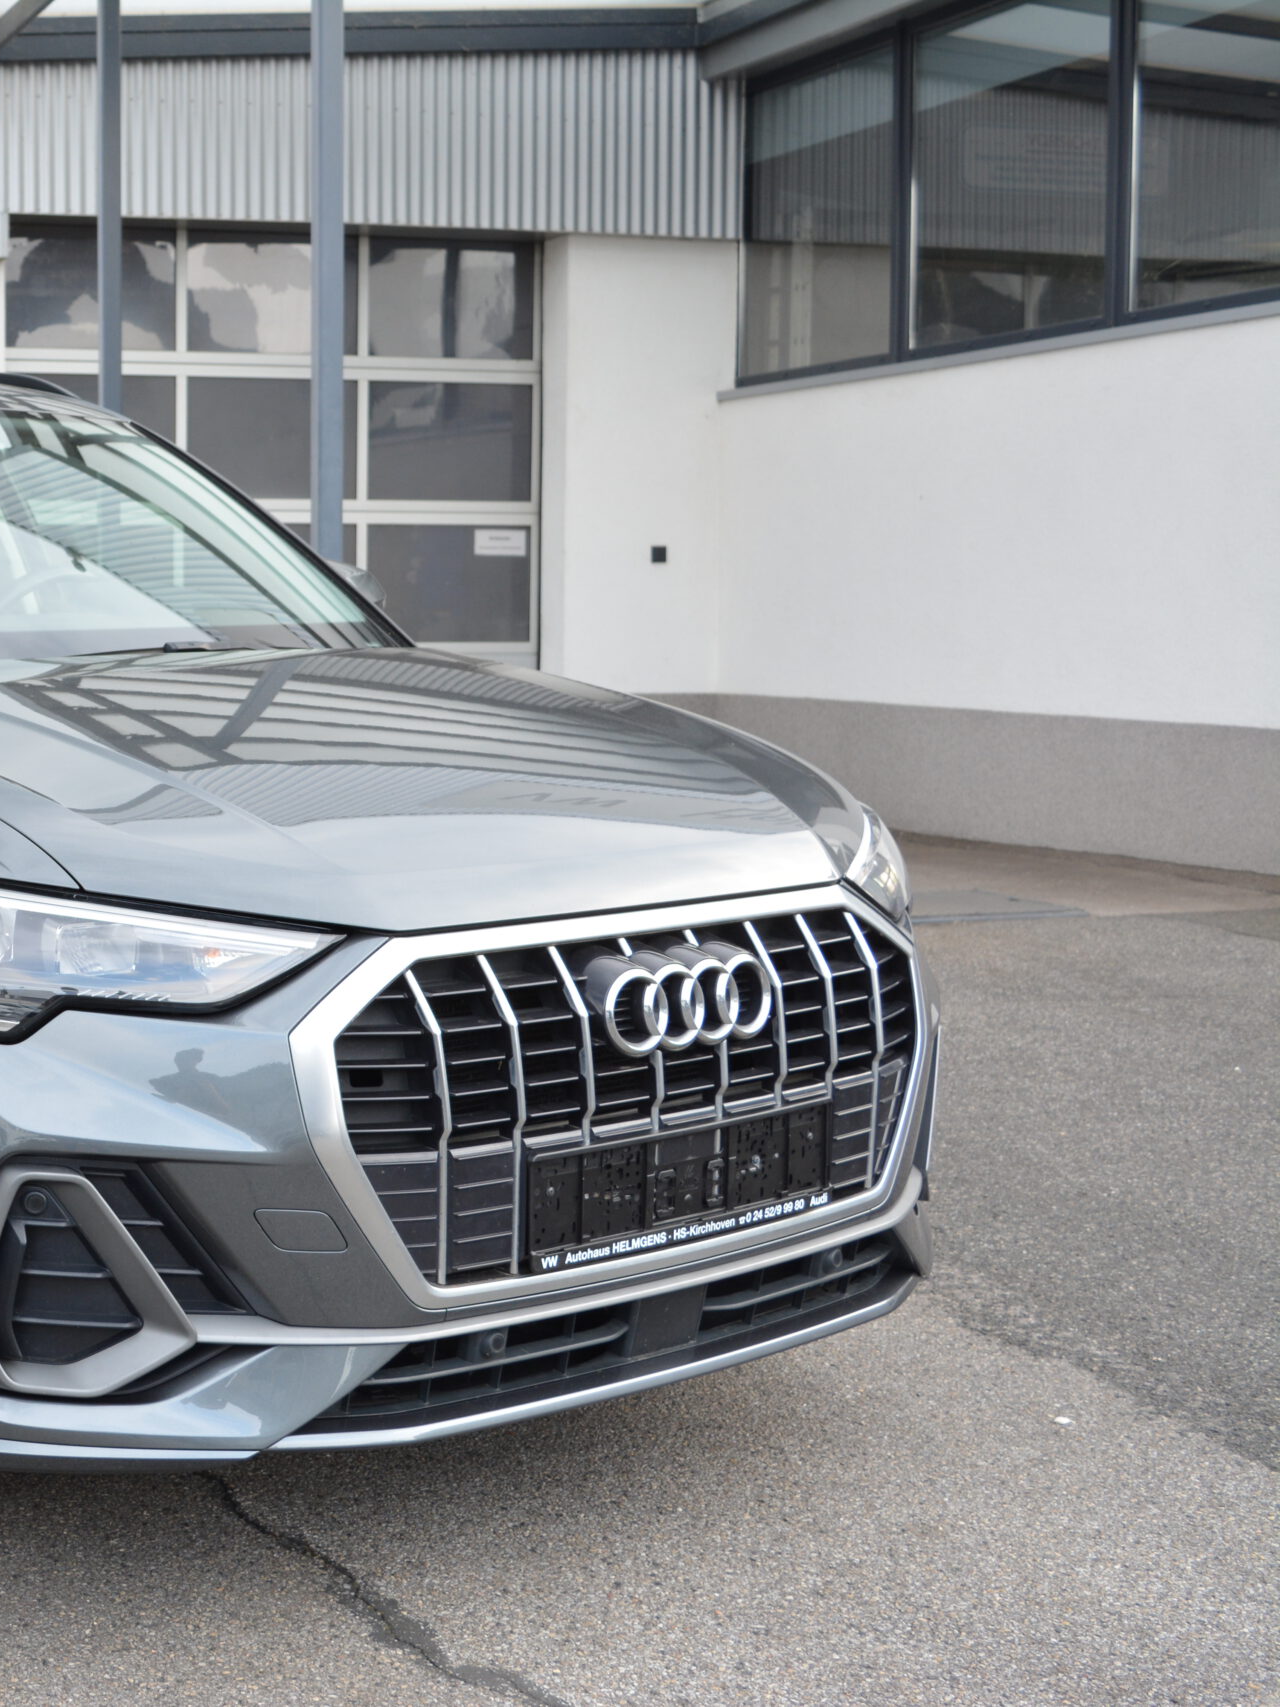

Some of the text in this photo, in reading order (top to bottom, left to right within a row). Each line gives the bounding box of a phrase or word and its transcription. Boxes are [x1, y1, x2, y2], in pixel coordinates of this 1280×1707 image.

[541, 1255, 558, 1269] VW
[565, 1245, 610, 1264] Autohaus
[612, 1231, 667, 1254] HELMGENS
[673, 1217, 735, 1241] HS-Kirchhoven
[810, 1192, 828, 1207] Audi
